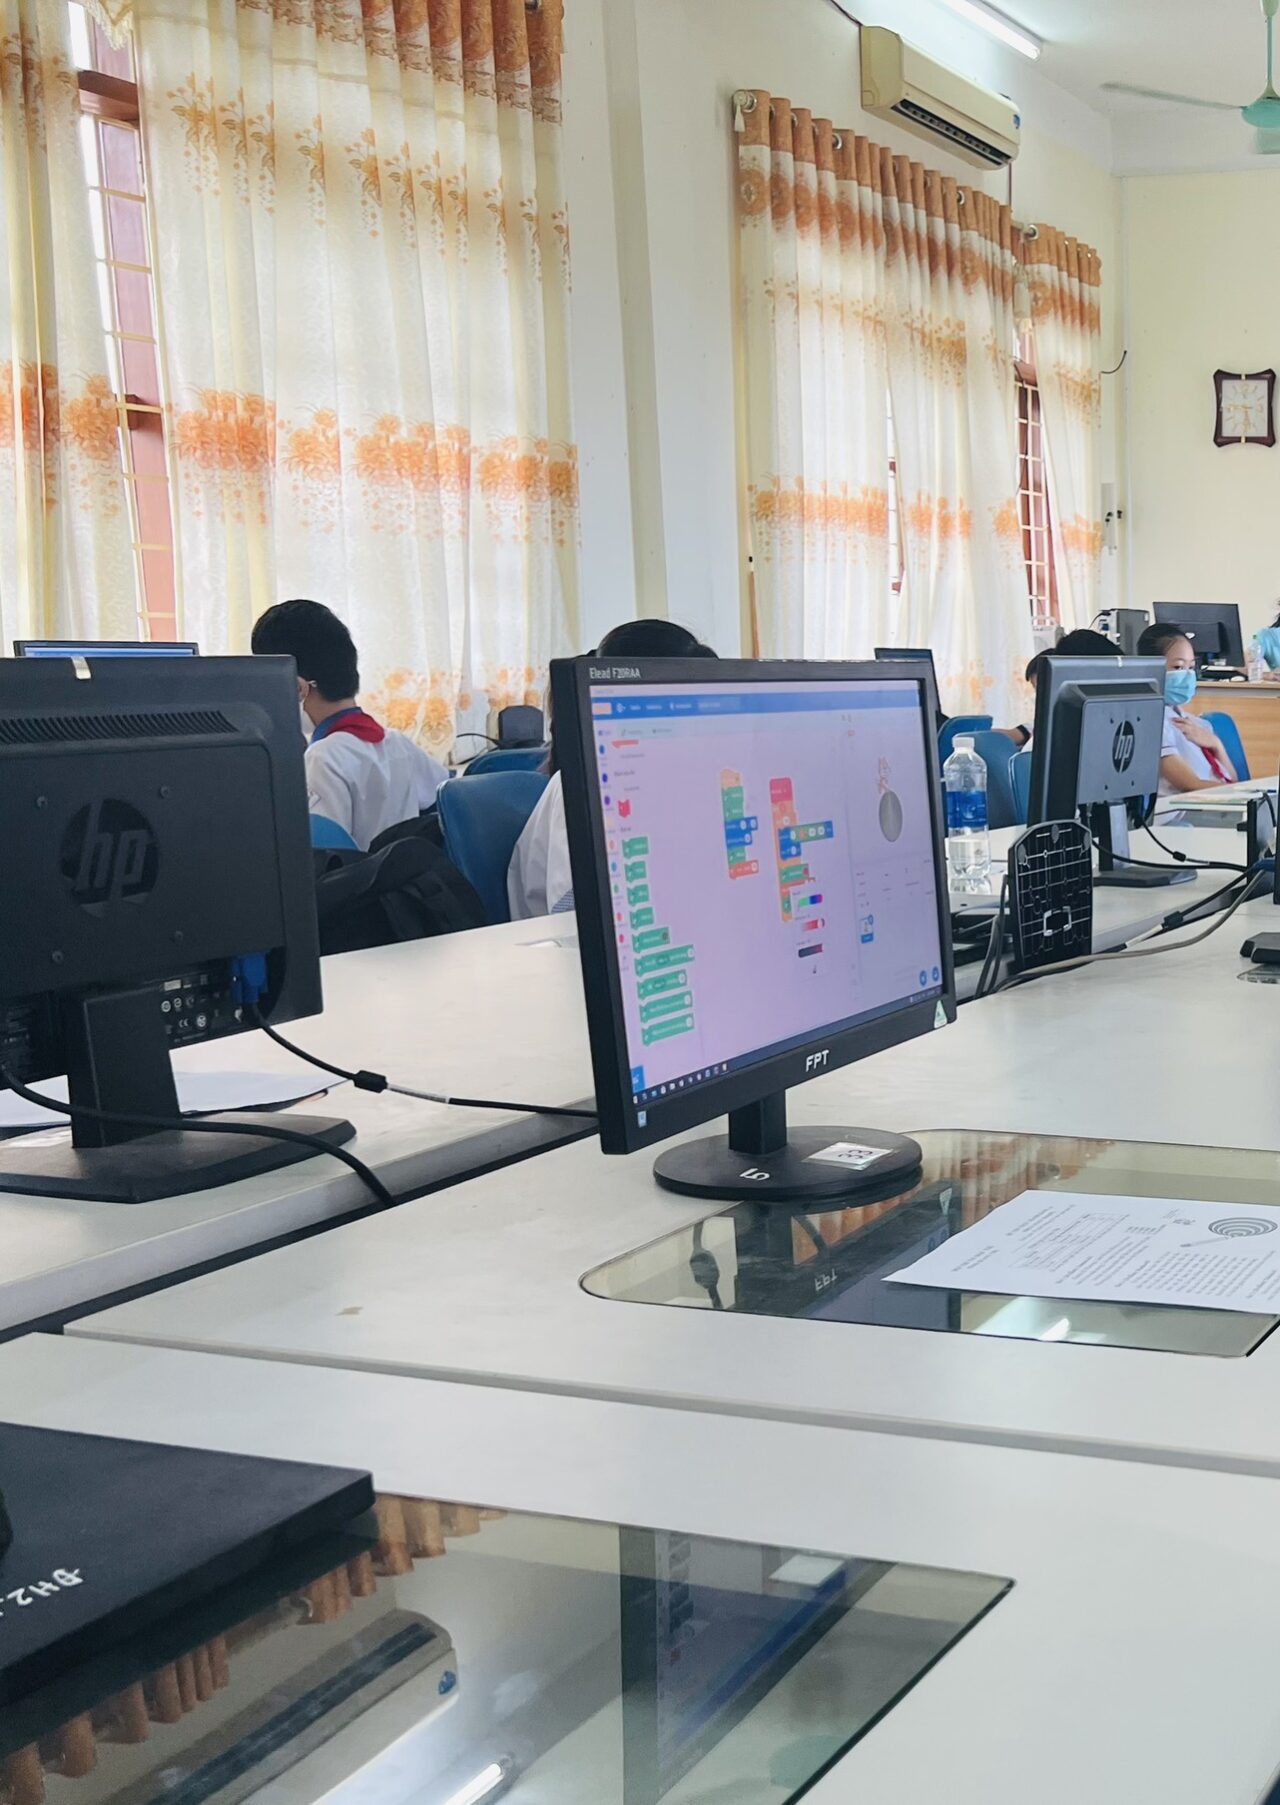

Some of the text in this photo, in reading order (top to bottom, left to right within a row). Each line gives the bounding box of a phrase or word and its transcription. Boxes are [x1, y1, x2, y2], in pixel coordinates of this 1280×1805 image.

[1113, 720, 1135, 773] hp
[70, 799, 155, 908] hp
[805, 1049, 830, 1072] FPT
